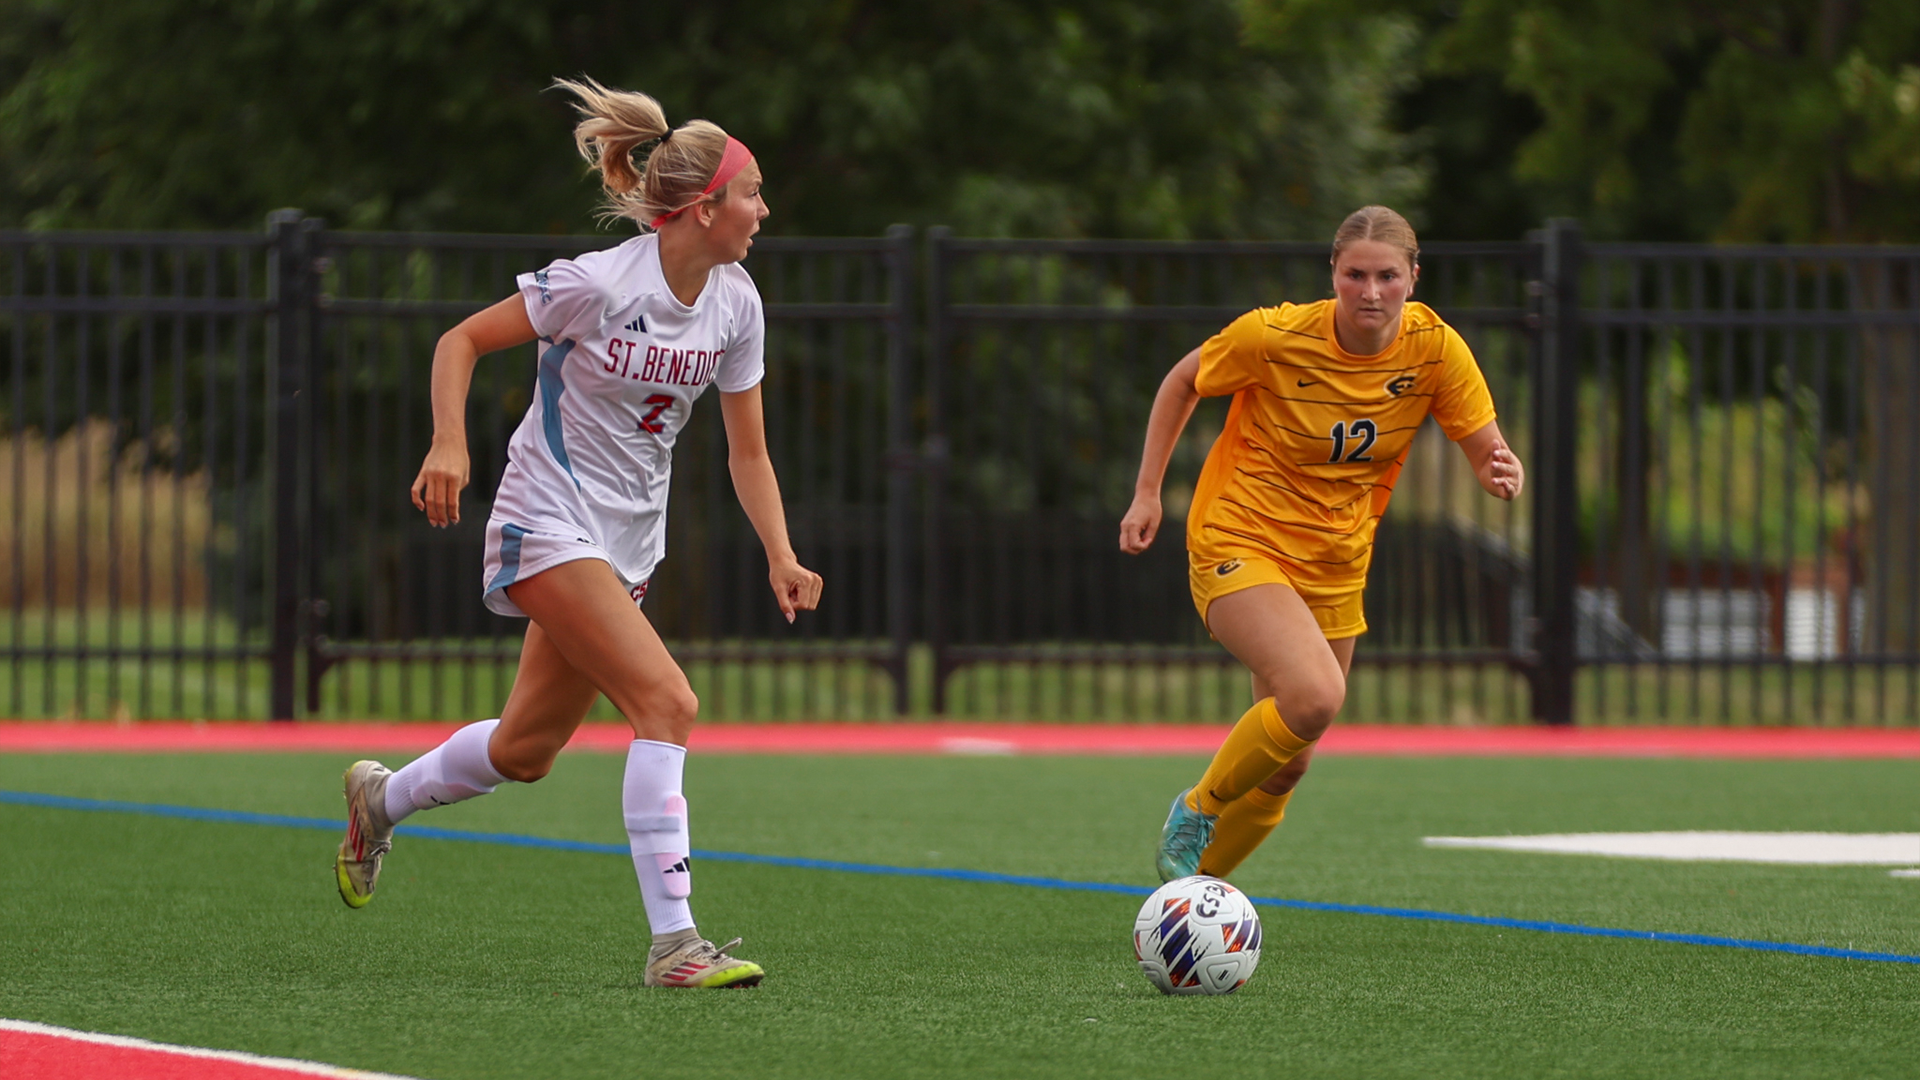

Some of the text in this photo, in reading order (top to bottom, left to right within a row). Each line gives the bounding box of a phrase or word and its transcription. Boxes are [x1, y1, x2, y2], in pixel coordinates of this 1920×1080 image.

[636, 392, 676, 435] 2
[1327, 418, 1377, 464] 12
[630, 578, 650, 602] CS
